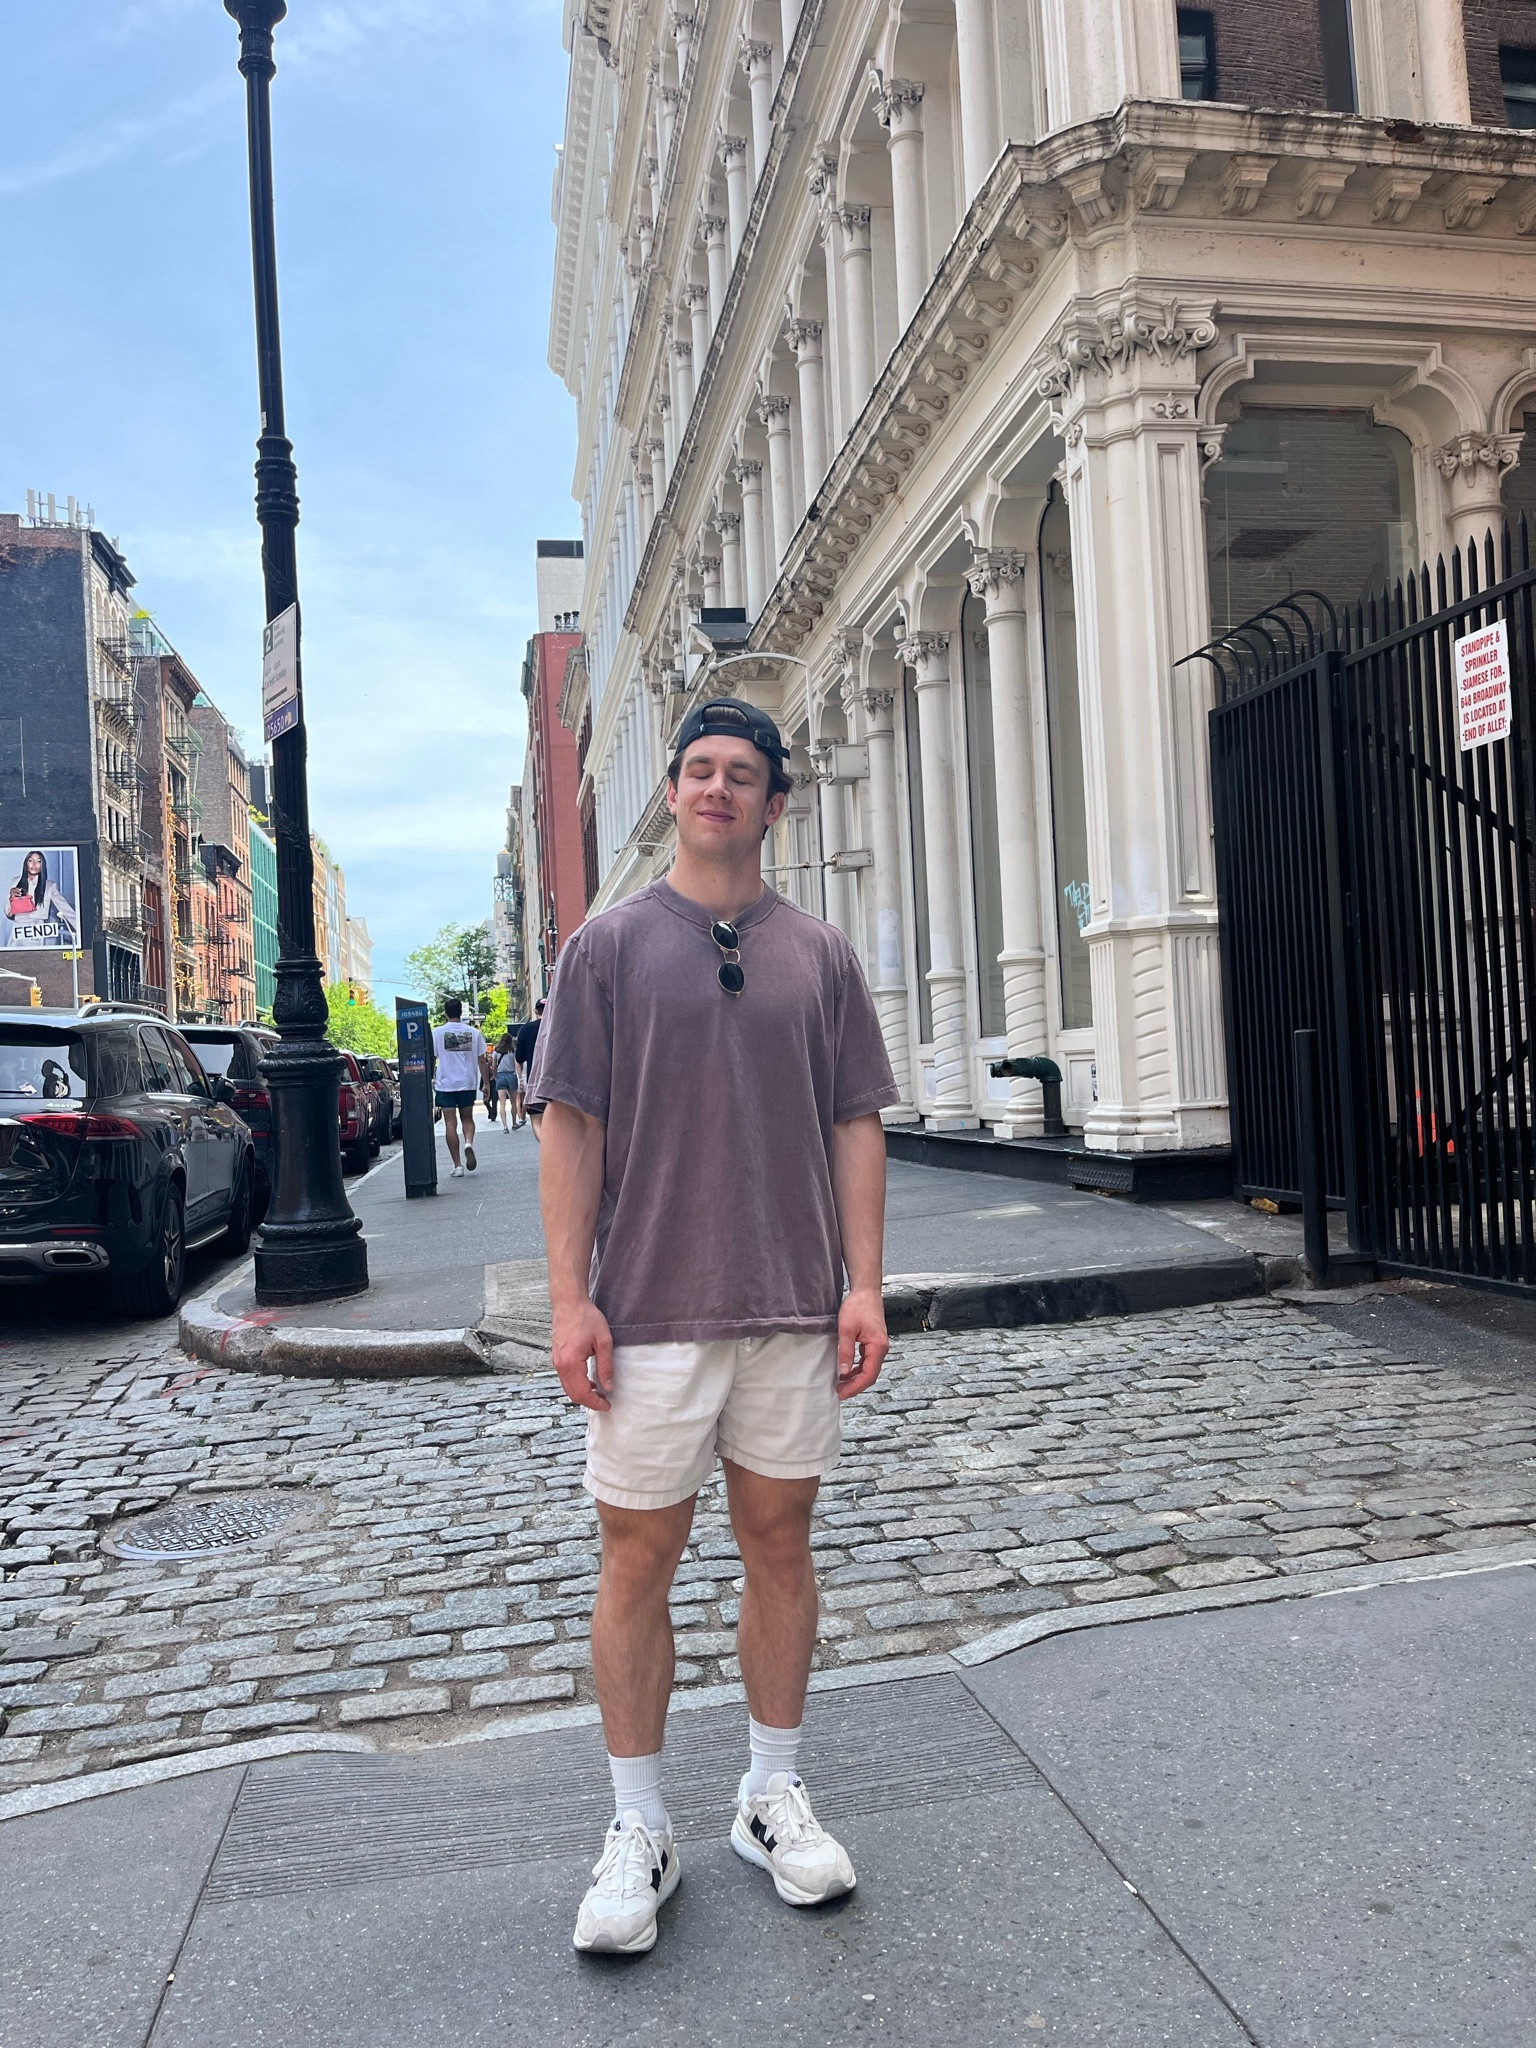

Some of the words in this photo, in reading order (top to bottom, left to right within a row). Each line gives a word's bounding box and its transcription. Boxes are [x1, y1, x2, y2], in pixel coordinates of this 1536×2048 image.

[265, 628, 272, 653] 2
[1461, 633, 1494, 657] STANDPIPE
[1495, 630, 1501, 643] &
[1464, 649, 1498, 673] SPRINKLER
[1462, 670, 1489, 691] SIAMESE
[1490, 665, 1503, 681] FOR
[1460, 694, 1472, 709] 648
[1472, 681, 1507, 705] BROADWAY
[1463, 712, 1470, 725] IS
[1470, 702, 1497, 722] LOCATED
[1498, 699, 1506, 713] AT
[1464, 726, 1477, 742] END
[1477, 723, 1486, 737] OF
[14, 923, 57, 939] FENDI
[406, 1021, 419, 1040] P
